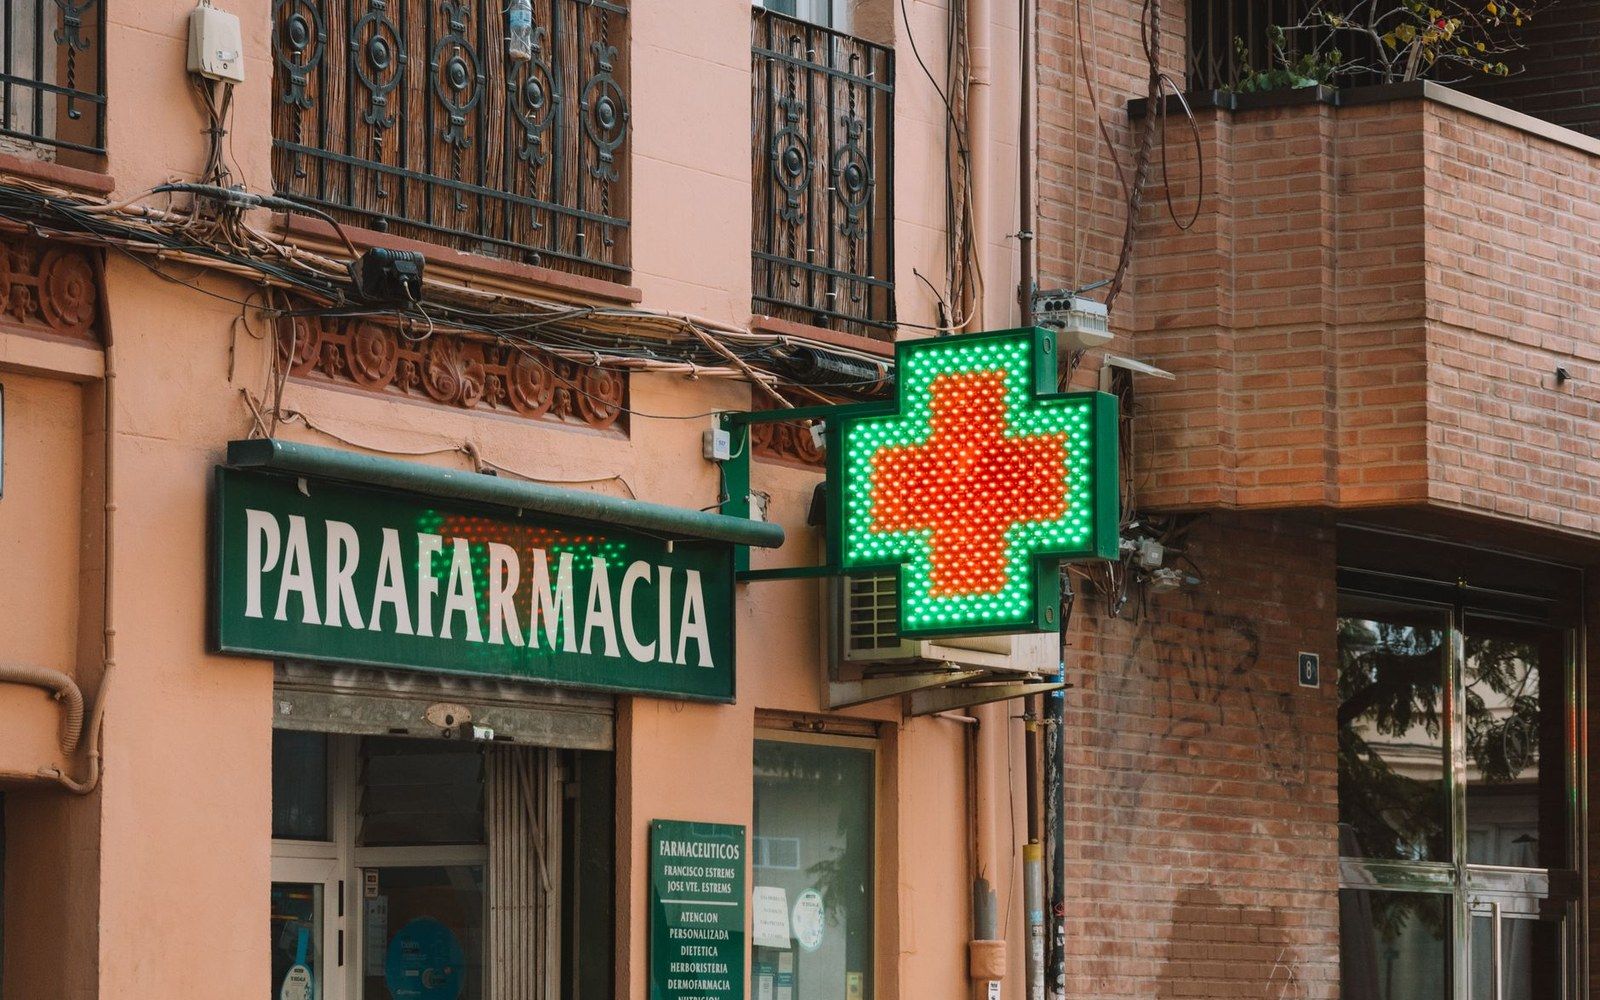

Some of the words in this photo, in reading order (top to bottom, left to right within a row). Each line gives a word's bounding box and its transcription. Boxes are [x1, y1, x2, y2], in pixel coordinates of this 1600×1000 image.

[245, 508, 715, 668] PARAFARMACIA
[1306, 660, 1312, 680] 8
[660, 840, 739, 860] FARMACEUTICOS
[664, 865, 704, 877] FRANCISCO
[705, 867, 735, 879] ESTREMS
[667, 880, 684, 893] JOSE
[686, 881, 700, 892] VTE.
[702, 882, 732, 893] ESTREMS
[680, 911, 719, 923] ATENCION
[669, 928, 729, 940] PERSONALIZADA
[680, 945, 718, 957] DIETETICA
[670, 962, 728, 974] HERBORISTERIA
[667, 979, 731, 990] DERMOFARMACIA
